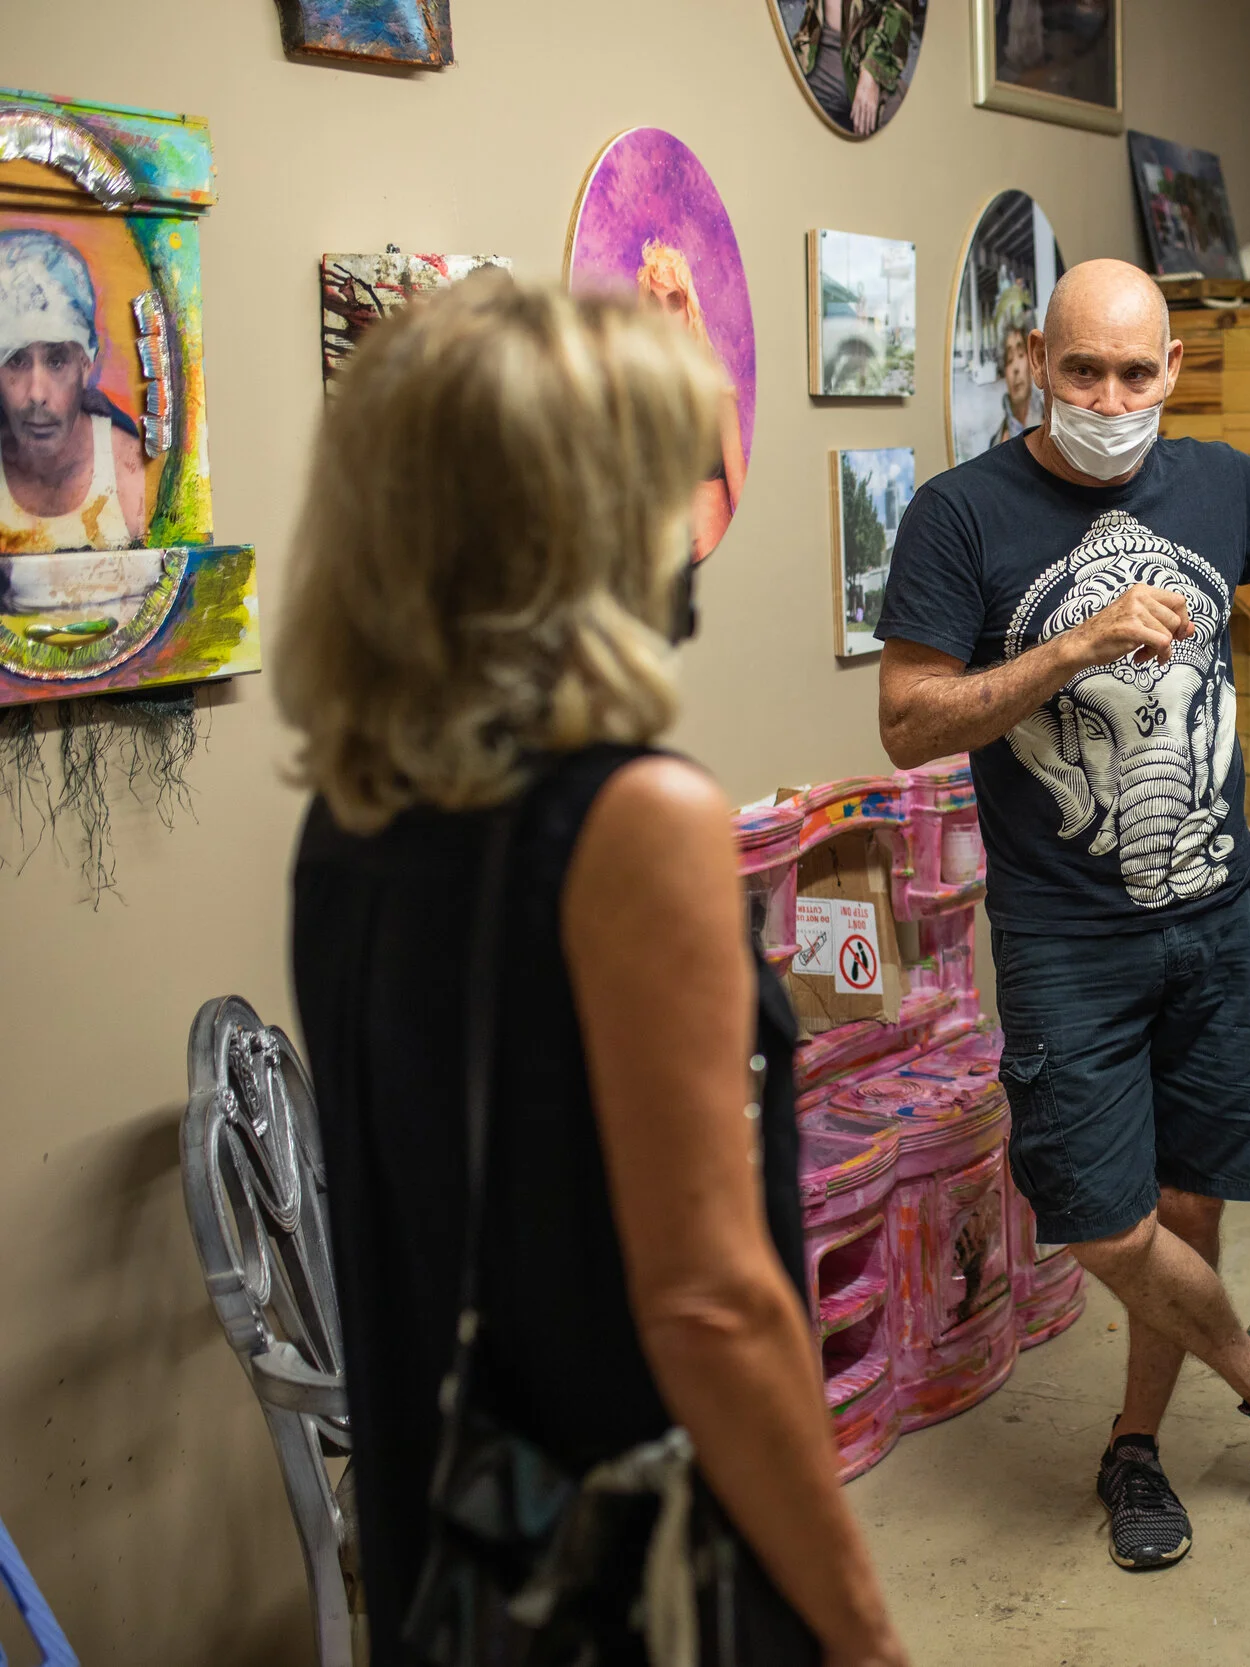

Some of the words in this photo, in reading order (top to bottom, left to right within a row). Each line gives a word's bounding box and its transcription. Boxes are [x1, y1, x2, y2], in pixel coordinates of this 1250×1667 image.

[853, 908, 868, 918] STEP
[806, 915, 819, 923] NOT
[848, 920, 866, 930] DON'T
